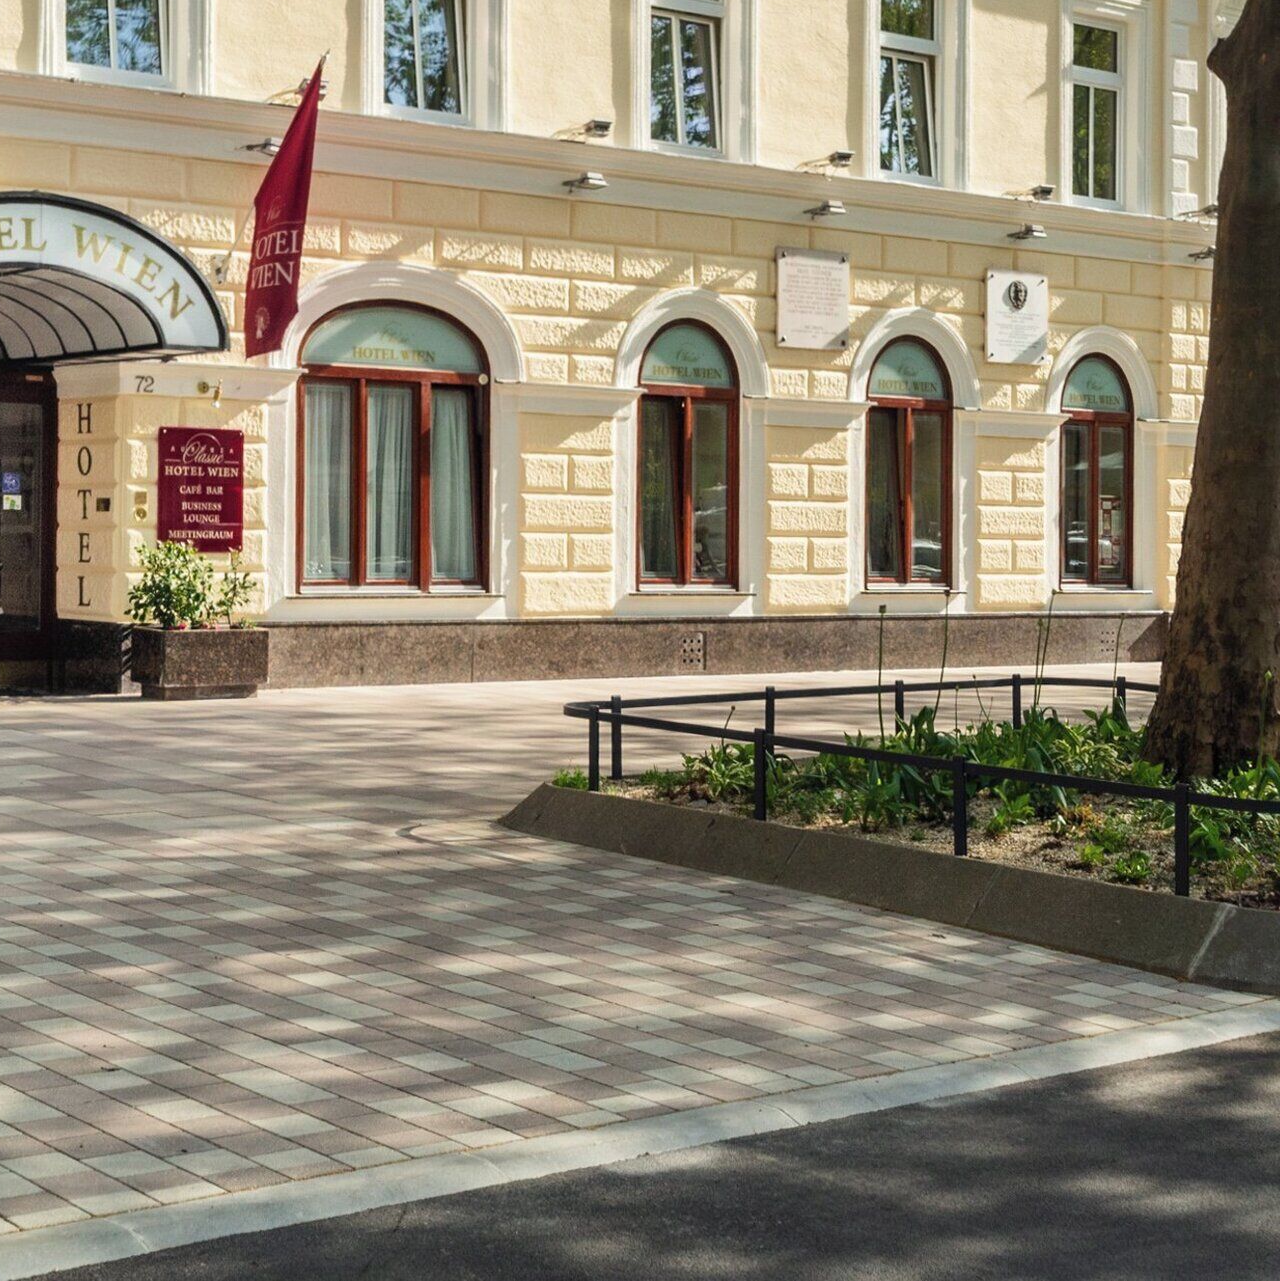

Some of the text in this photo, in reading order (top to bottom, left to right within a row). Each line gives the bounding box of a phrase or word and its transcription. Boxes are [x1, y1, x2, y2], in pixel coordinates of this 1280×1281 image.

[72, 223, 194, 320] WIEN
[352, 346, 436, 363] HOTEL WIEN
[652, 365, 691, 377] HOTEL
[135, 375, 154, 393] 72
[165, 465, 239, 478] HOTEL WIEN
[179, 484, 223, 495] CAFÉ BAR
[77, 403, 92, 607] HOTEL
[181, 502, 222, 511] BUSINESS
[183, 514, 220, 524] LOUNGE
[168, 530, 234, 540] MEETINGRAUM
